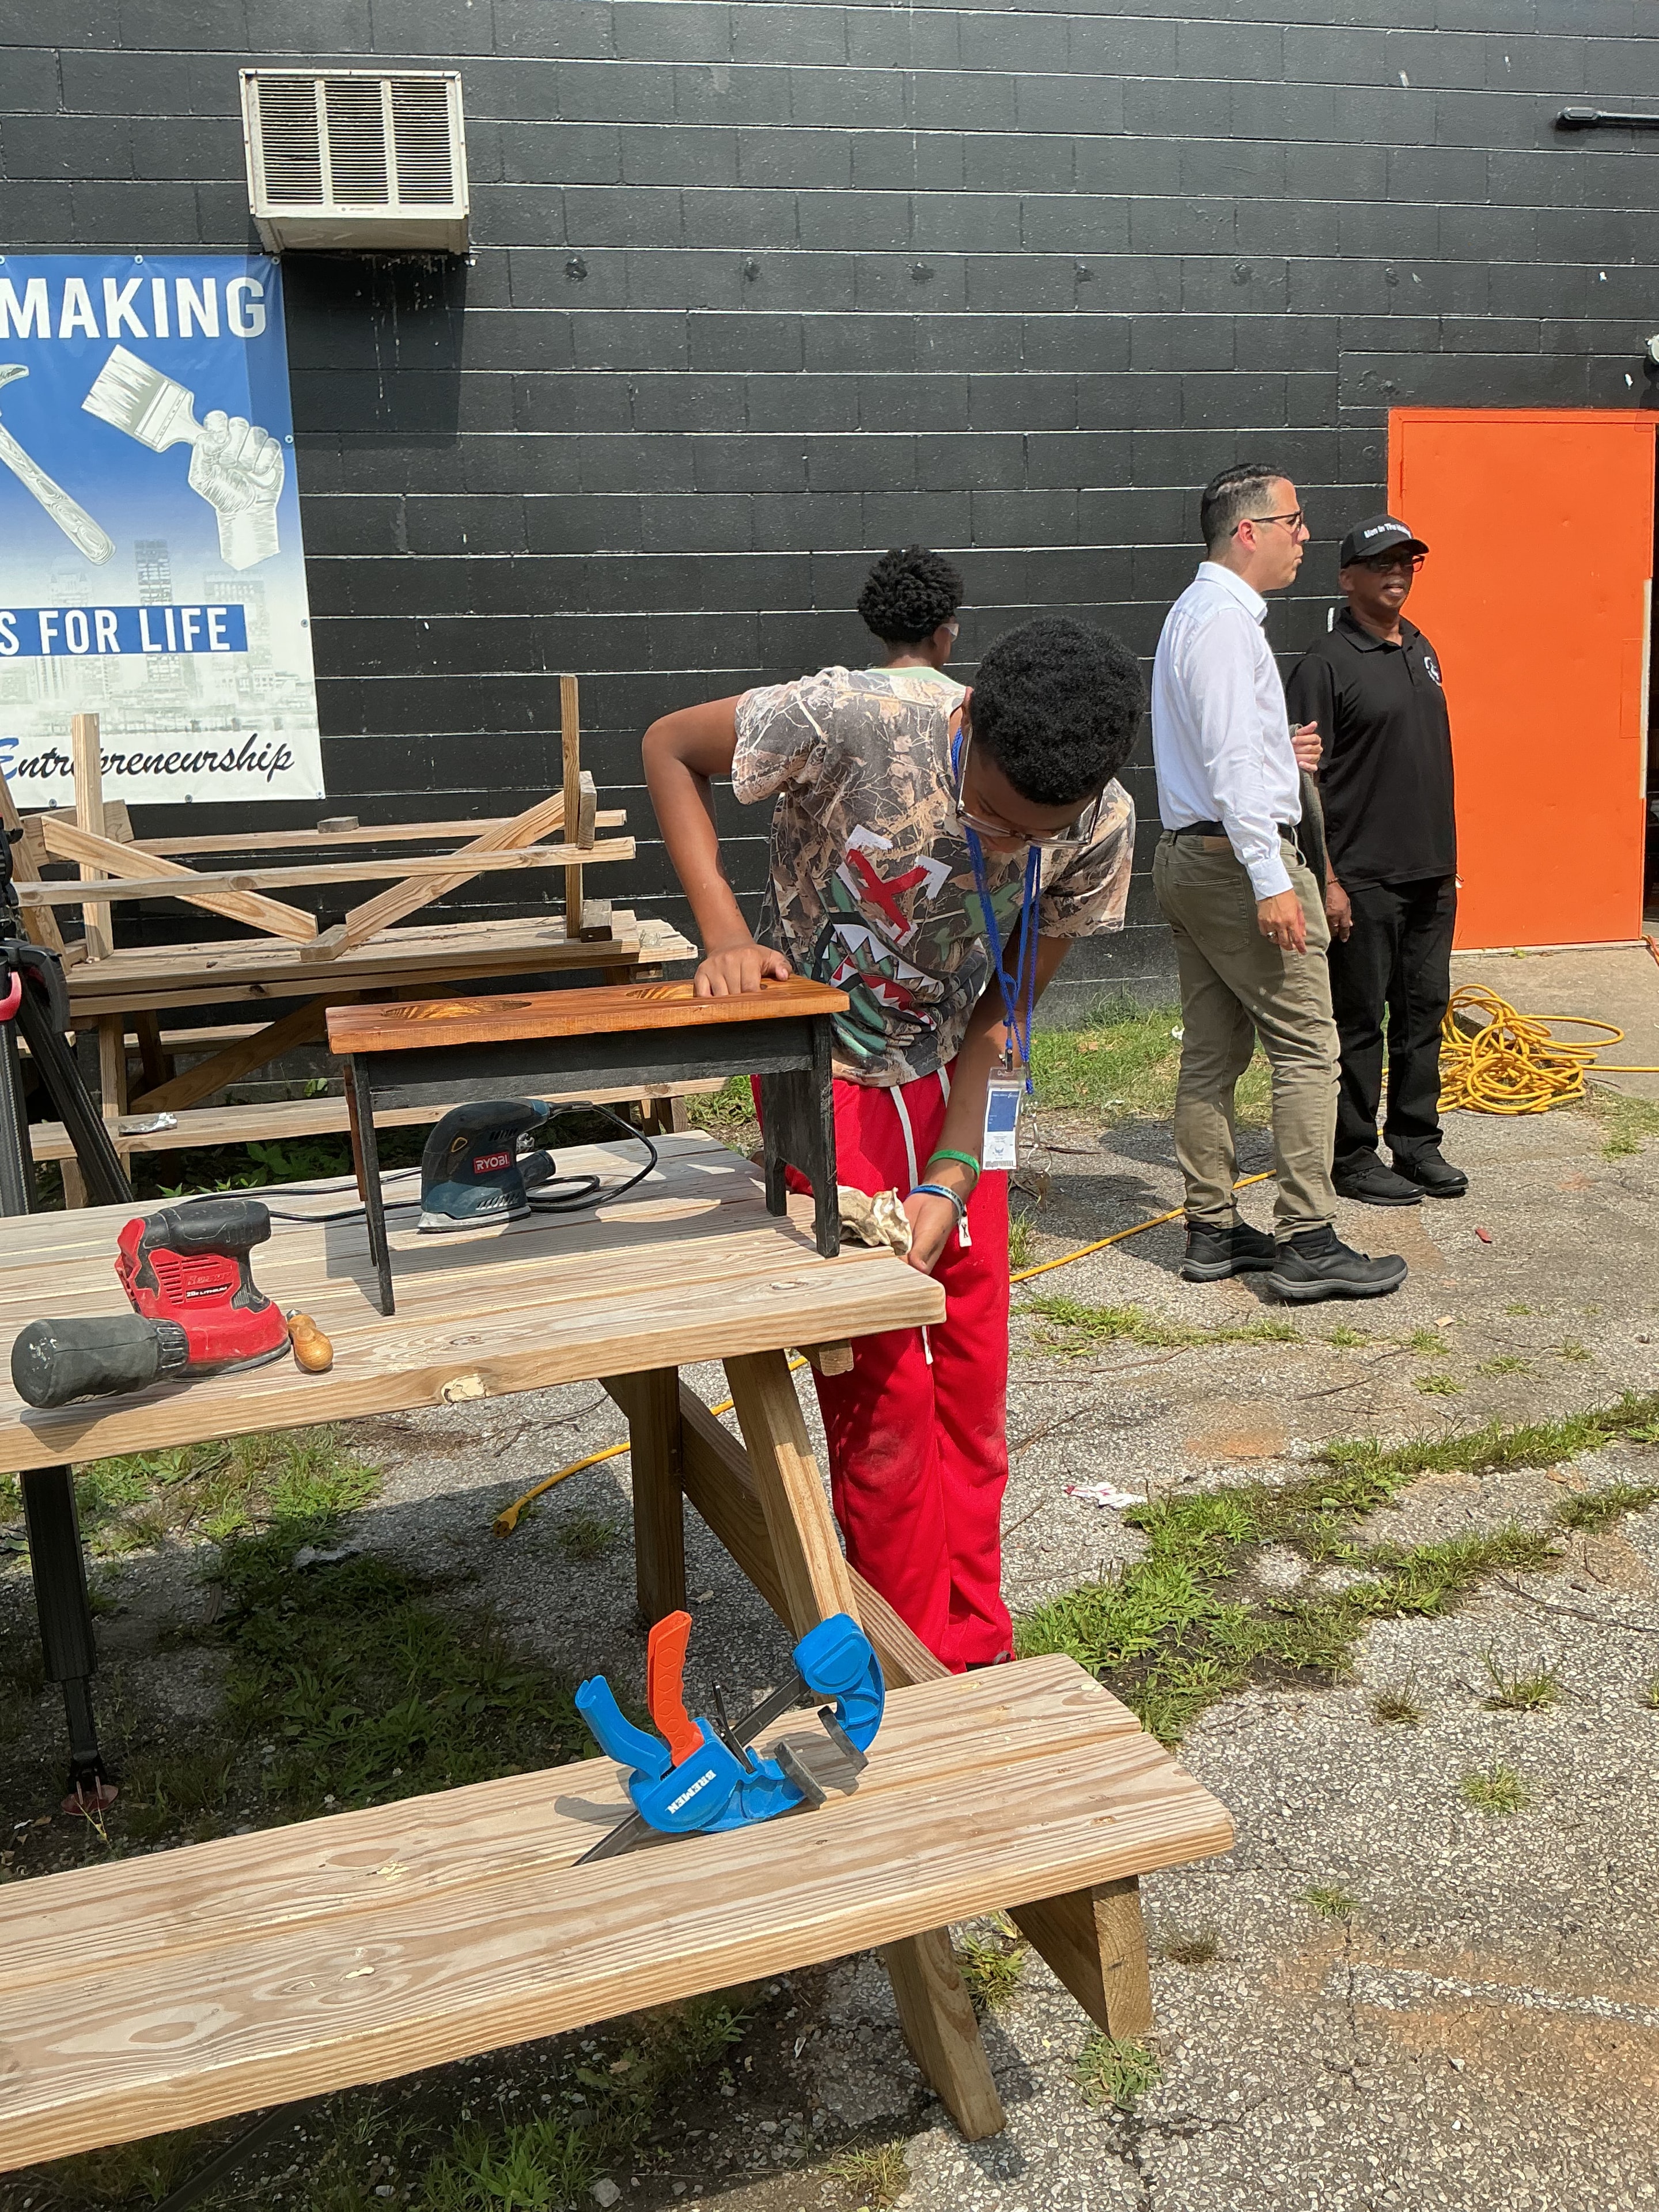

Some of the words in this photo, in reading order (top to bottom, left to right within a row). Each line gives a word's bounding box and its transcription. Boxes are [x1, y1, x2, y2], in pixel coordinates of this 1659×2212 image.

[0, 278, 266, 339] MAKING
[39, 609, 120, 654] FOR
[139, 608, 230, 652] LIFE
[0, 733, 294, 783] Entrreneurship
[475, 1154, 508, 1171] RYOBI
[200, 1286, 228, 1295] LITHIUM
[665, 1769, 717, 1815] BREMEN
